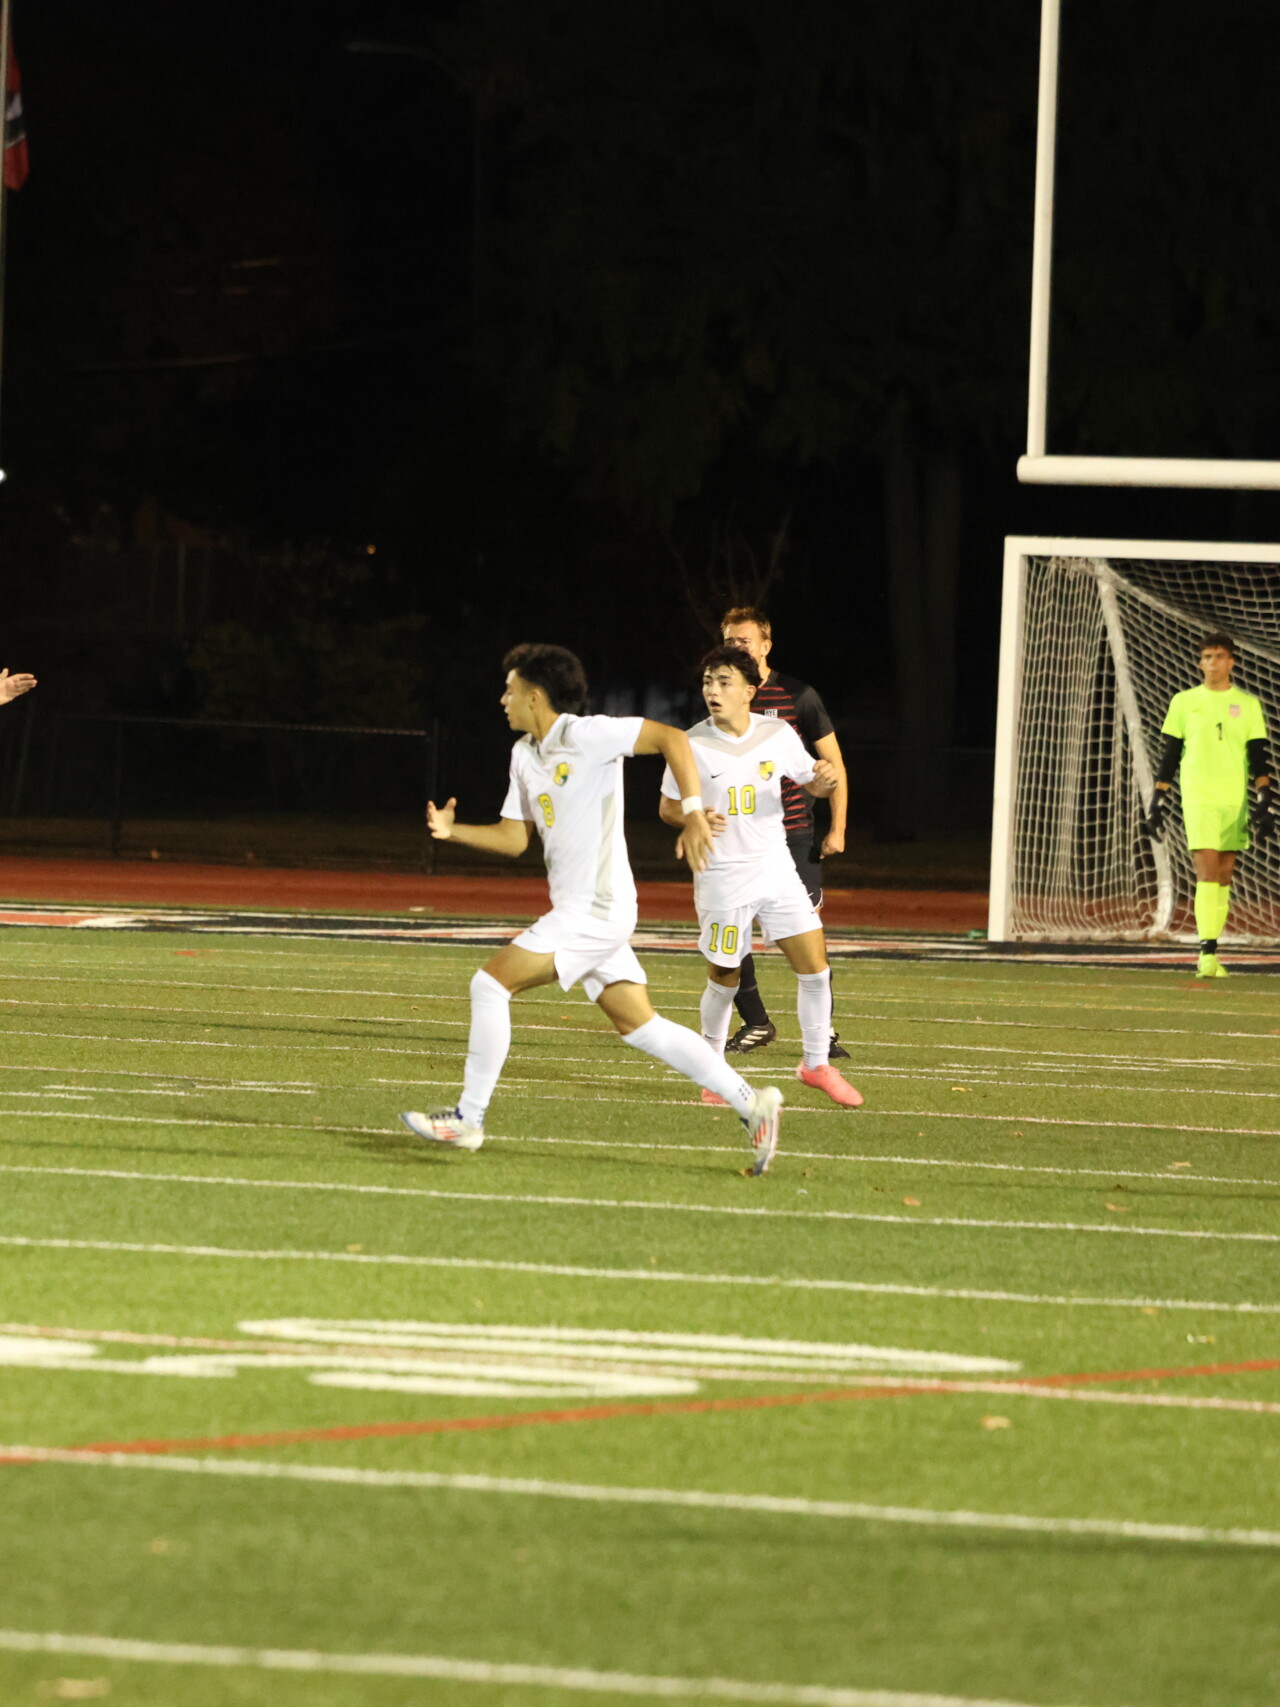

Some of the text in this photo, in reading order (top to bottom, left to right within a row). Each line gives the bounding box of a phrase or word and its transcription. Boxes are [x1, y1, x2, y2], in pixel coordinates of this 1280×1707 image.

[1216, 722, 1223, 741] 1
[537, 793, 556, 828] 8
[728, 785, 756, 815] 10
[708, 922, 739, 955] 10
